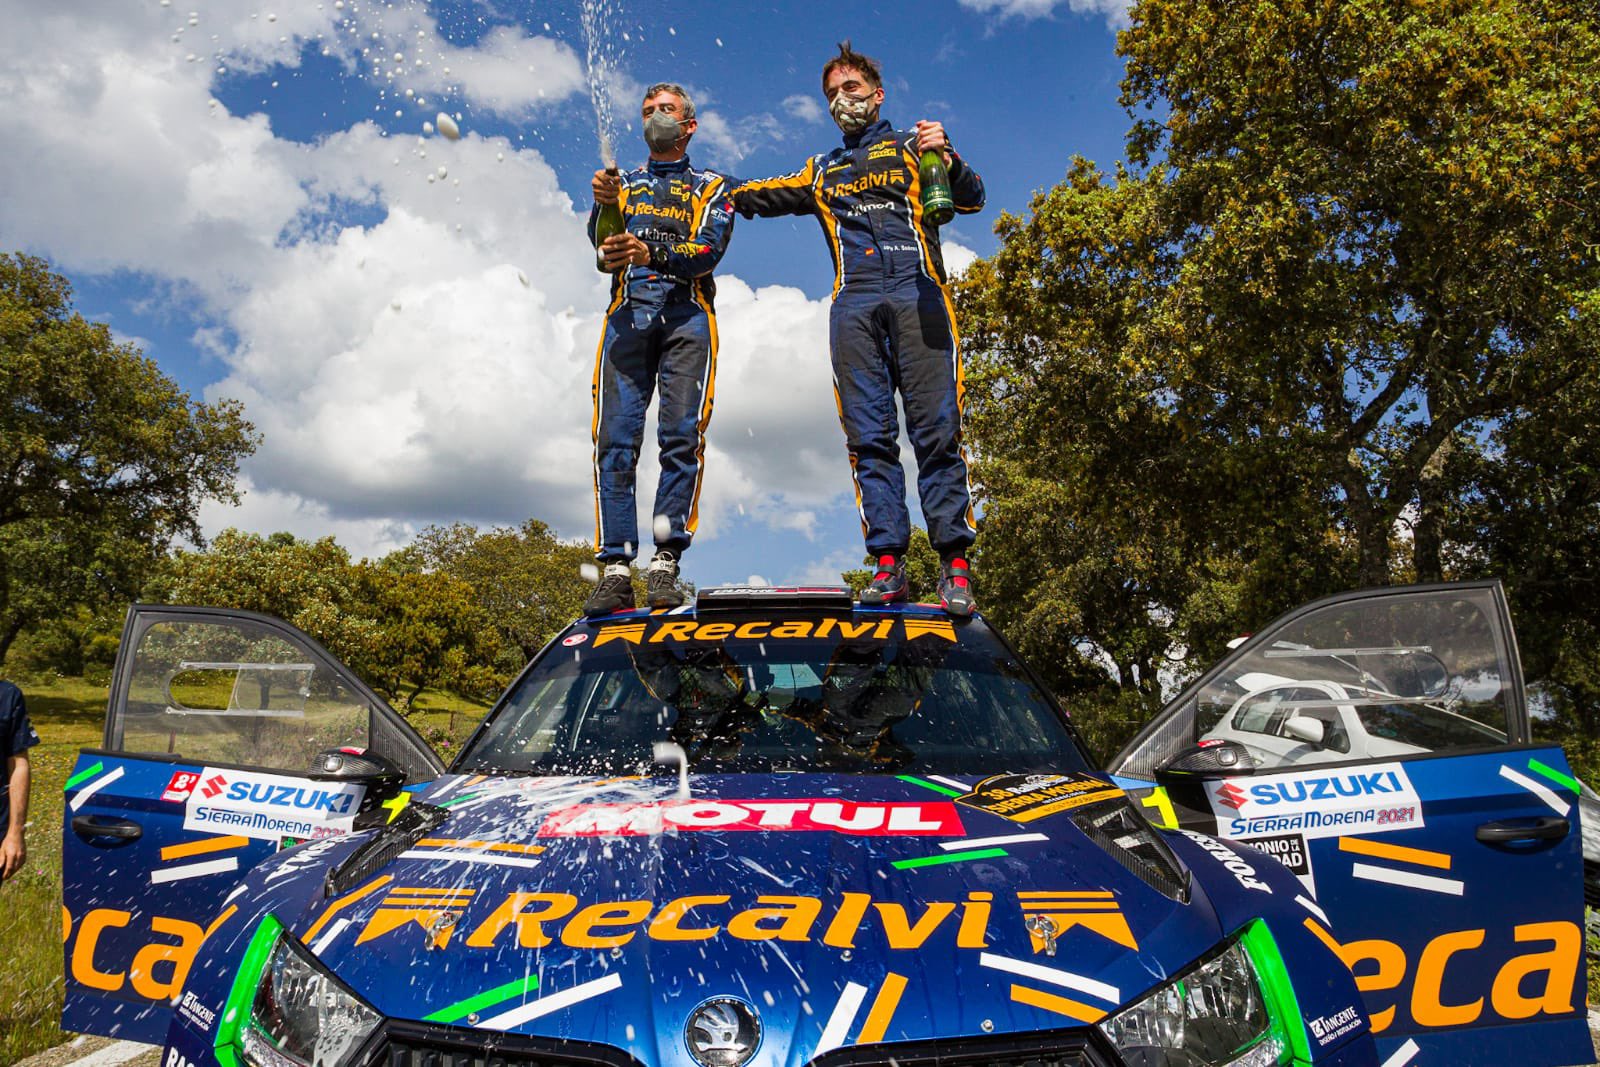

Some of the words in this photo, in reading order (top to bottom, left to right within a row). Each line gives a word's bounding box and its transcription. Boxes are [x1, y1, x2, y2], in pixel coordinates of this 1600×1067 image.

[834, 171, 888, 198] Recalvi
[634, 202, 687, 221] Recalvi
[648, 618, 894, 644] Recalvi
[226, 781, 354, 814] SUZUKI
[981, 788, 1014, 801] 38
[984, 792, 1051, 814] SIERRA
[1040, 779, 1110, 797] MORENA
[1249, 771, 1404, 805] SUZUKI
[553, 801, 943, 831] MOTUL
[1141, 786, 1179, 829] 1
[1376, 806, 1416, 825] 2021
[464, 890, 994, 950] Recalvi
